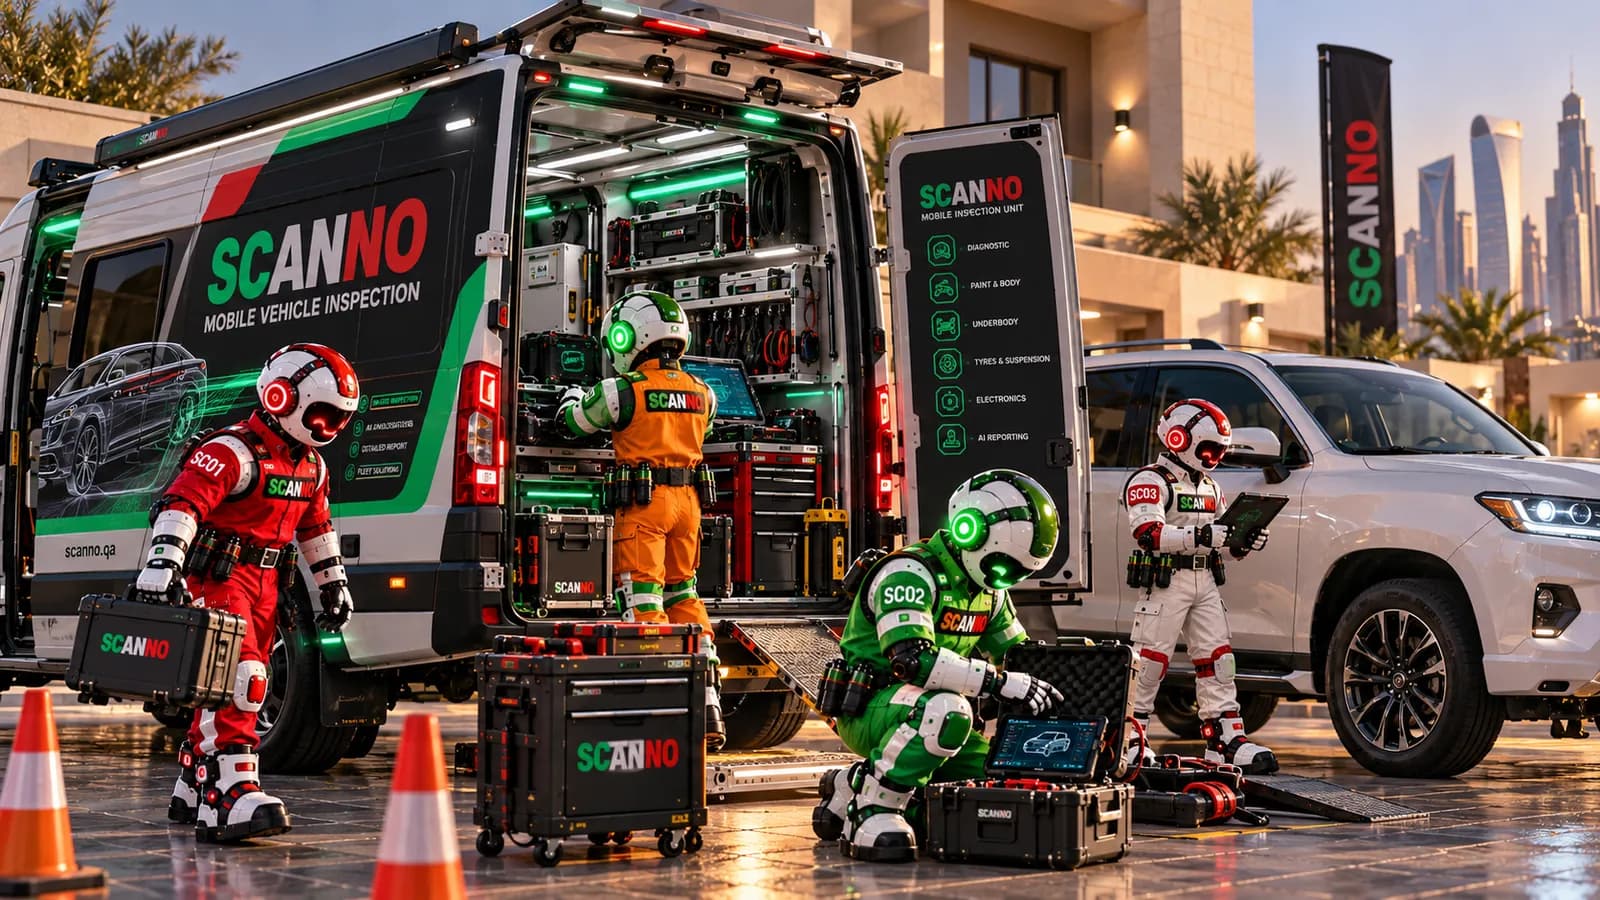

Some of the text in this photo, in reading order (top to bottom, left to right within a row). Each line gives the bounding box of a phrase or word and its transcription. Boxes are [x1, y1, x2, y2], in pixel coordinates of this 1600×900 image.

[920, 175, 1023, 209] SCANNO
[921, 210, 952, 221] MOBILE
[1003, 203, 1024, 213] UNIT
[1345, 119, 1383, 308] SCANNO
[207, 197, 428, 305] SCANNO
[967, 241, 1010, 252] DIAGNOSTIC
[970, 280, 991, 289] PAINT
[999, 279, 1021, 287] BODY
[203, 280, 421, 333] MOBILE VEHICLE INSPECTION
[972, 318, 1019, 328] UNDERBODY
[974, 358, 997, 366] TYRES
[1005, 355, 1051, 365] SUSPENSION
[976, 394, 1027, 404] ELECTRONICS
[978, 433, 1029, 442] AI REPORTING
[190, 451, 225, 477] SC01
[268, 478, 315, 498] SCANNO
[1130, 487, 1157, 501] SC03
[64, 543, 117, 560] scanno.qa
[555, 581, 595, 594] SCANNO
[884, 585, 925, 605] SC02
[100, 632, 169, 660] SCANNO
[576, 738, 680, 772] SCANNO
